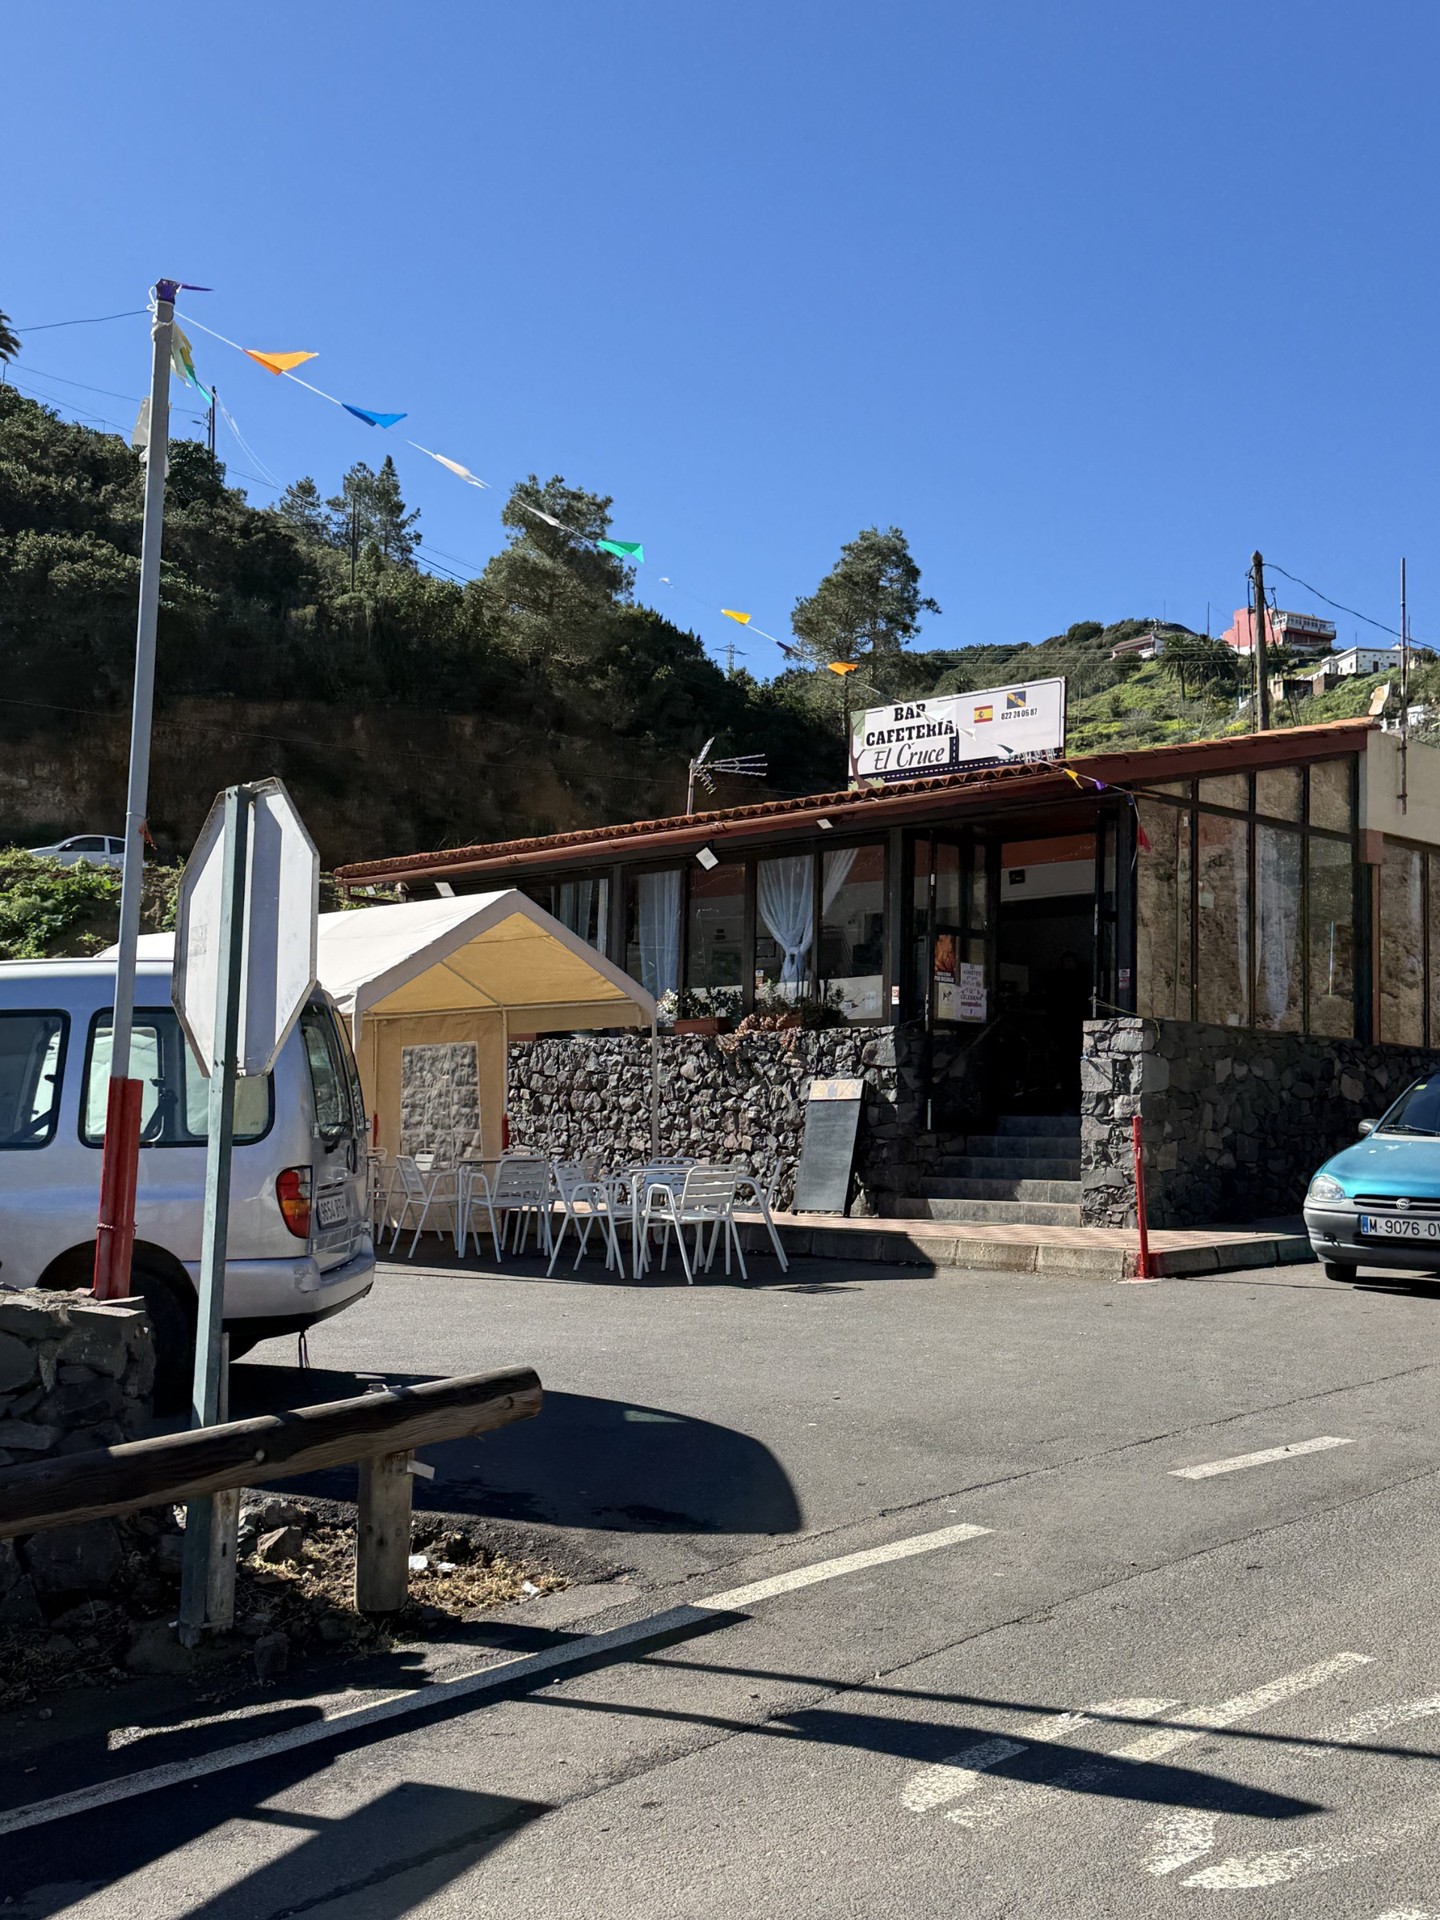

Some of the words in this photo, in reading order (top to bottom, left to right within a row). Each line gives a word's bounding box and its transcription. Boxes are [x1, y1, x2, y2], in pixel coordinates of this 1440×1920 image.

[894, 703, 926, 722] BAR
[1001, 711, 1013, 720] 822
[1030, 707, 1038, 716] 87
[874, 747, 892, 770] El
[896, 742, 945, 767] Cruce
